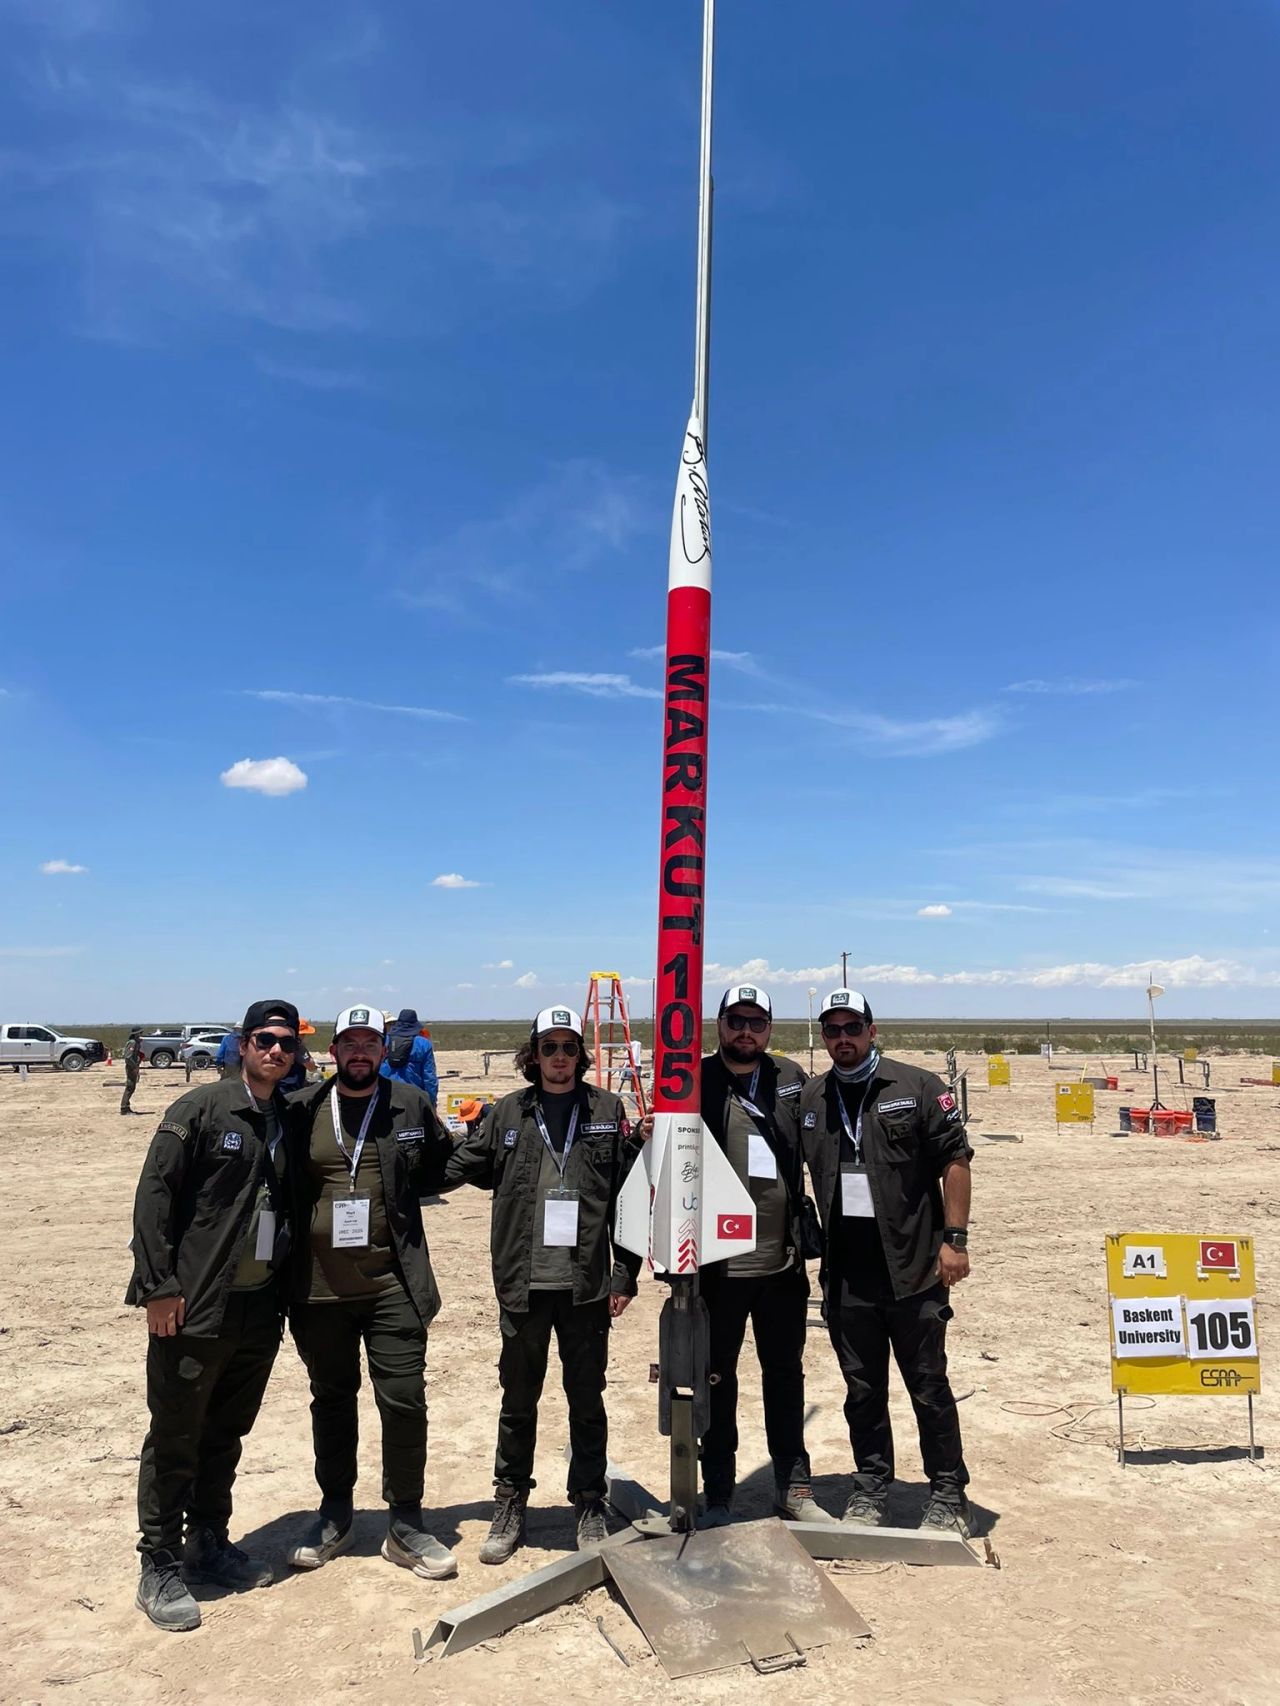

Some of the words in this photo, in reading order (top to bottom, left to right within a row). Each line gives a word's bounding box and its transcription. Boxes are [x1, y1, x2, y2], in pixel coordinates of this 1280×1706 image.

[663, 654, 704, 945] MARKUT
[659, 953, 695, 1100] 105
[1132, 1254, 1156, 1269] A1
[1122, 1308, 1174, 1323] Baskent
[1118, 1328, 1182, 1345] University
[1190, 1311, 1252, 1351] 105
